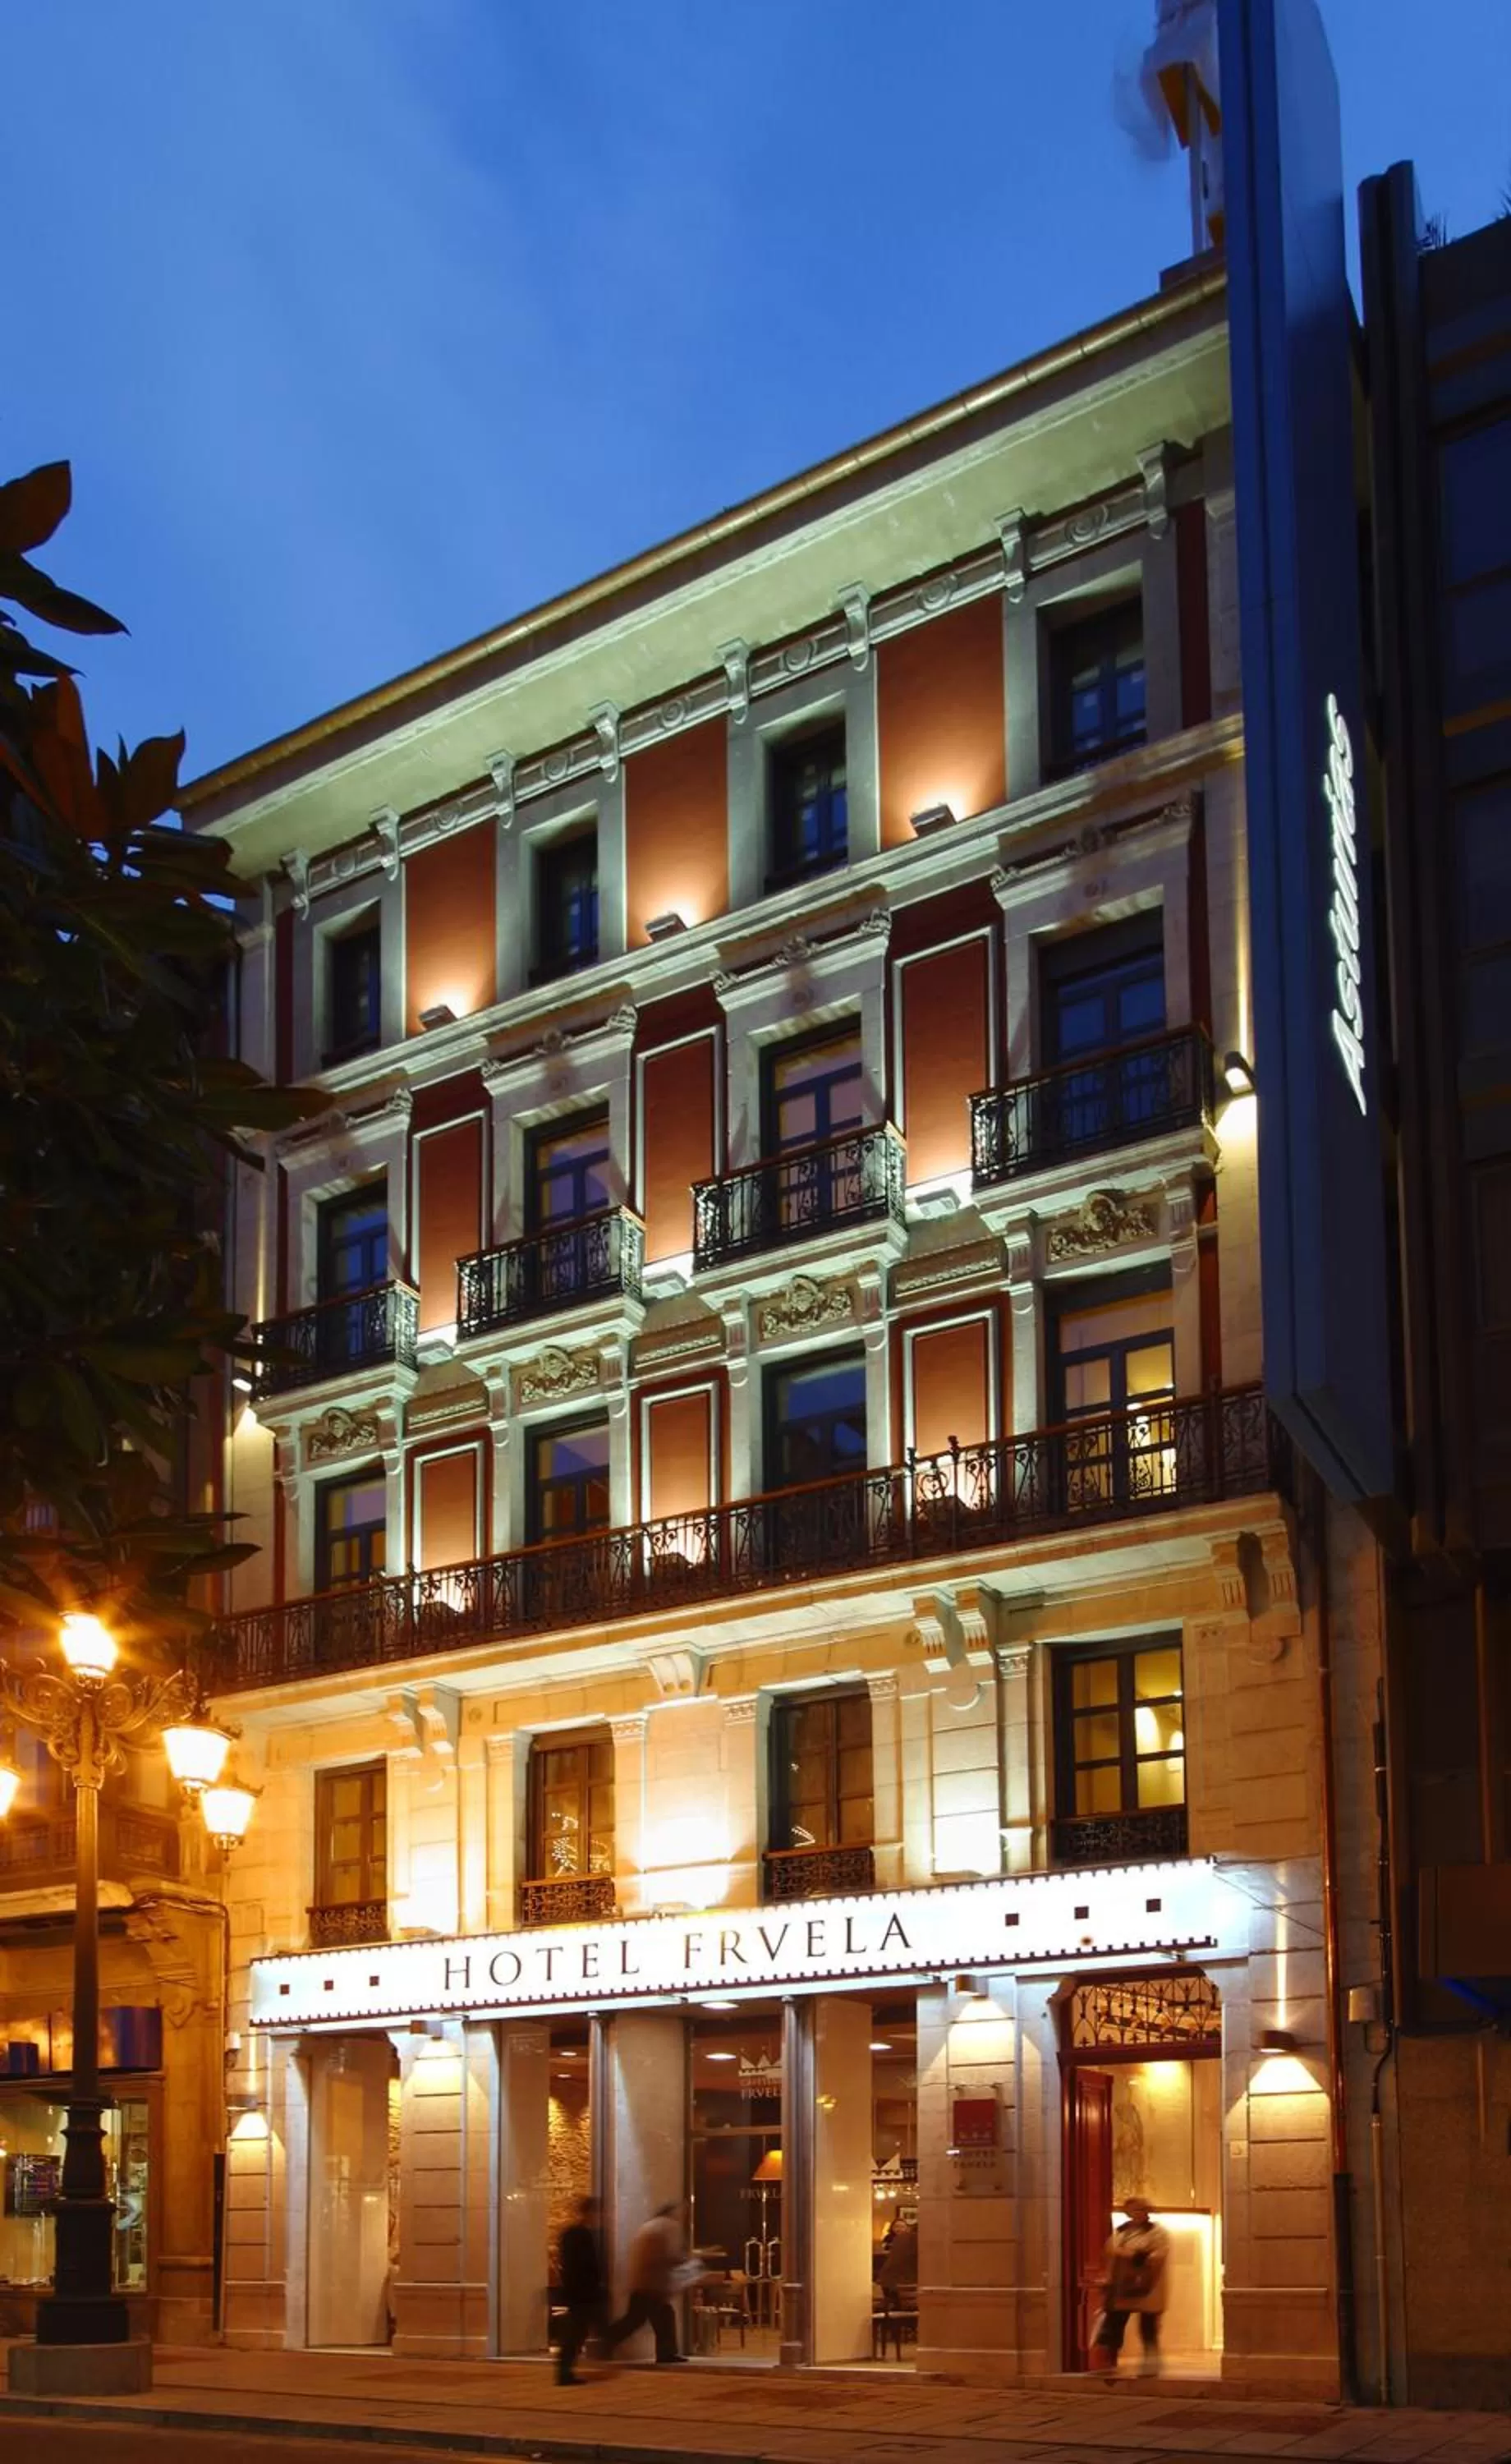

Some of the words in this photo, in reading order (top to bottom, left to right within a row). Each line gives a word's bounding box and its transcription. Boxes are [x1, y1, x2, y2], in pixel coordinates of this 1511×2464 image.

[1323, 692, 1366, 1116] Asturias
[444, 1939, 640, 1990] HOTEL
[684, 1912, 912, 1969] FRVELA
